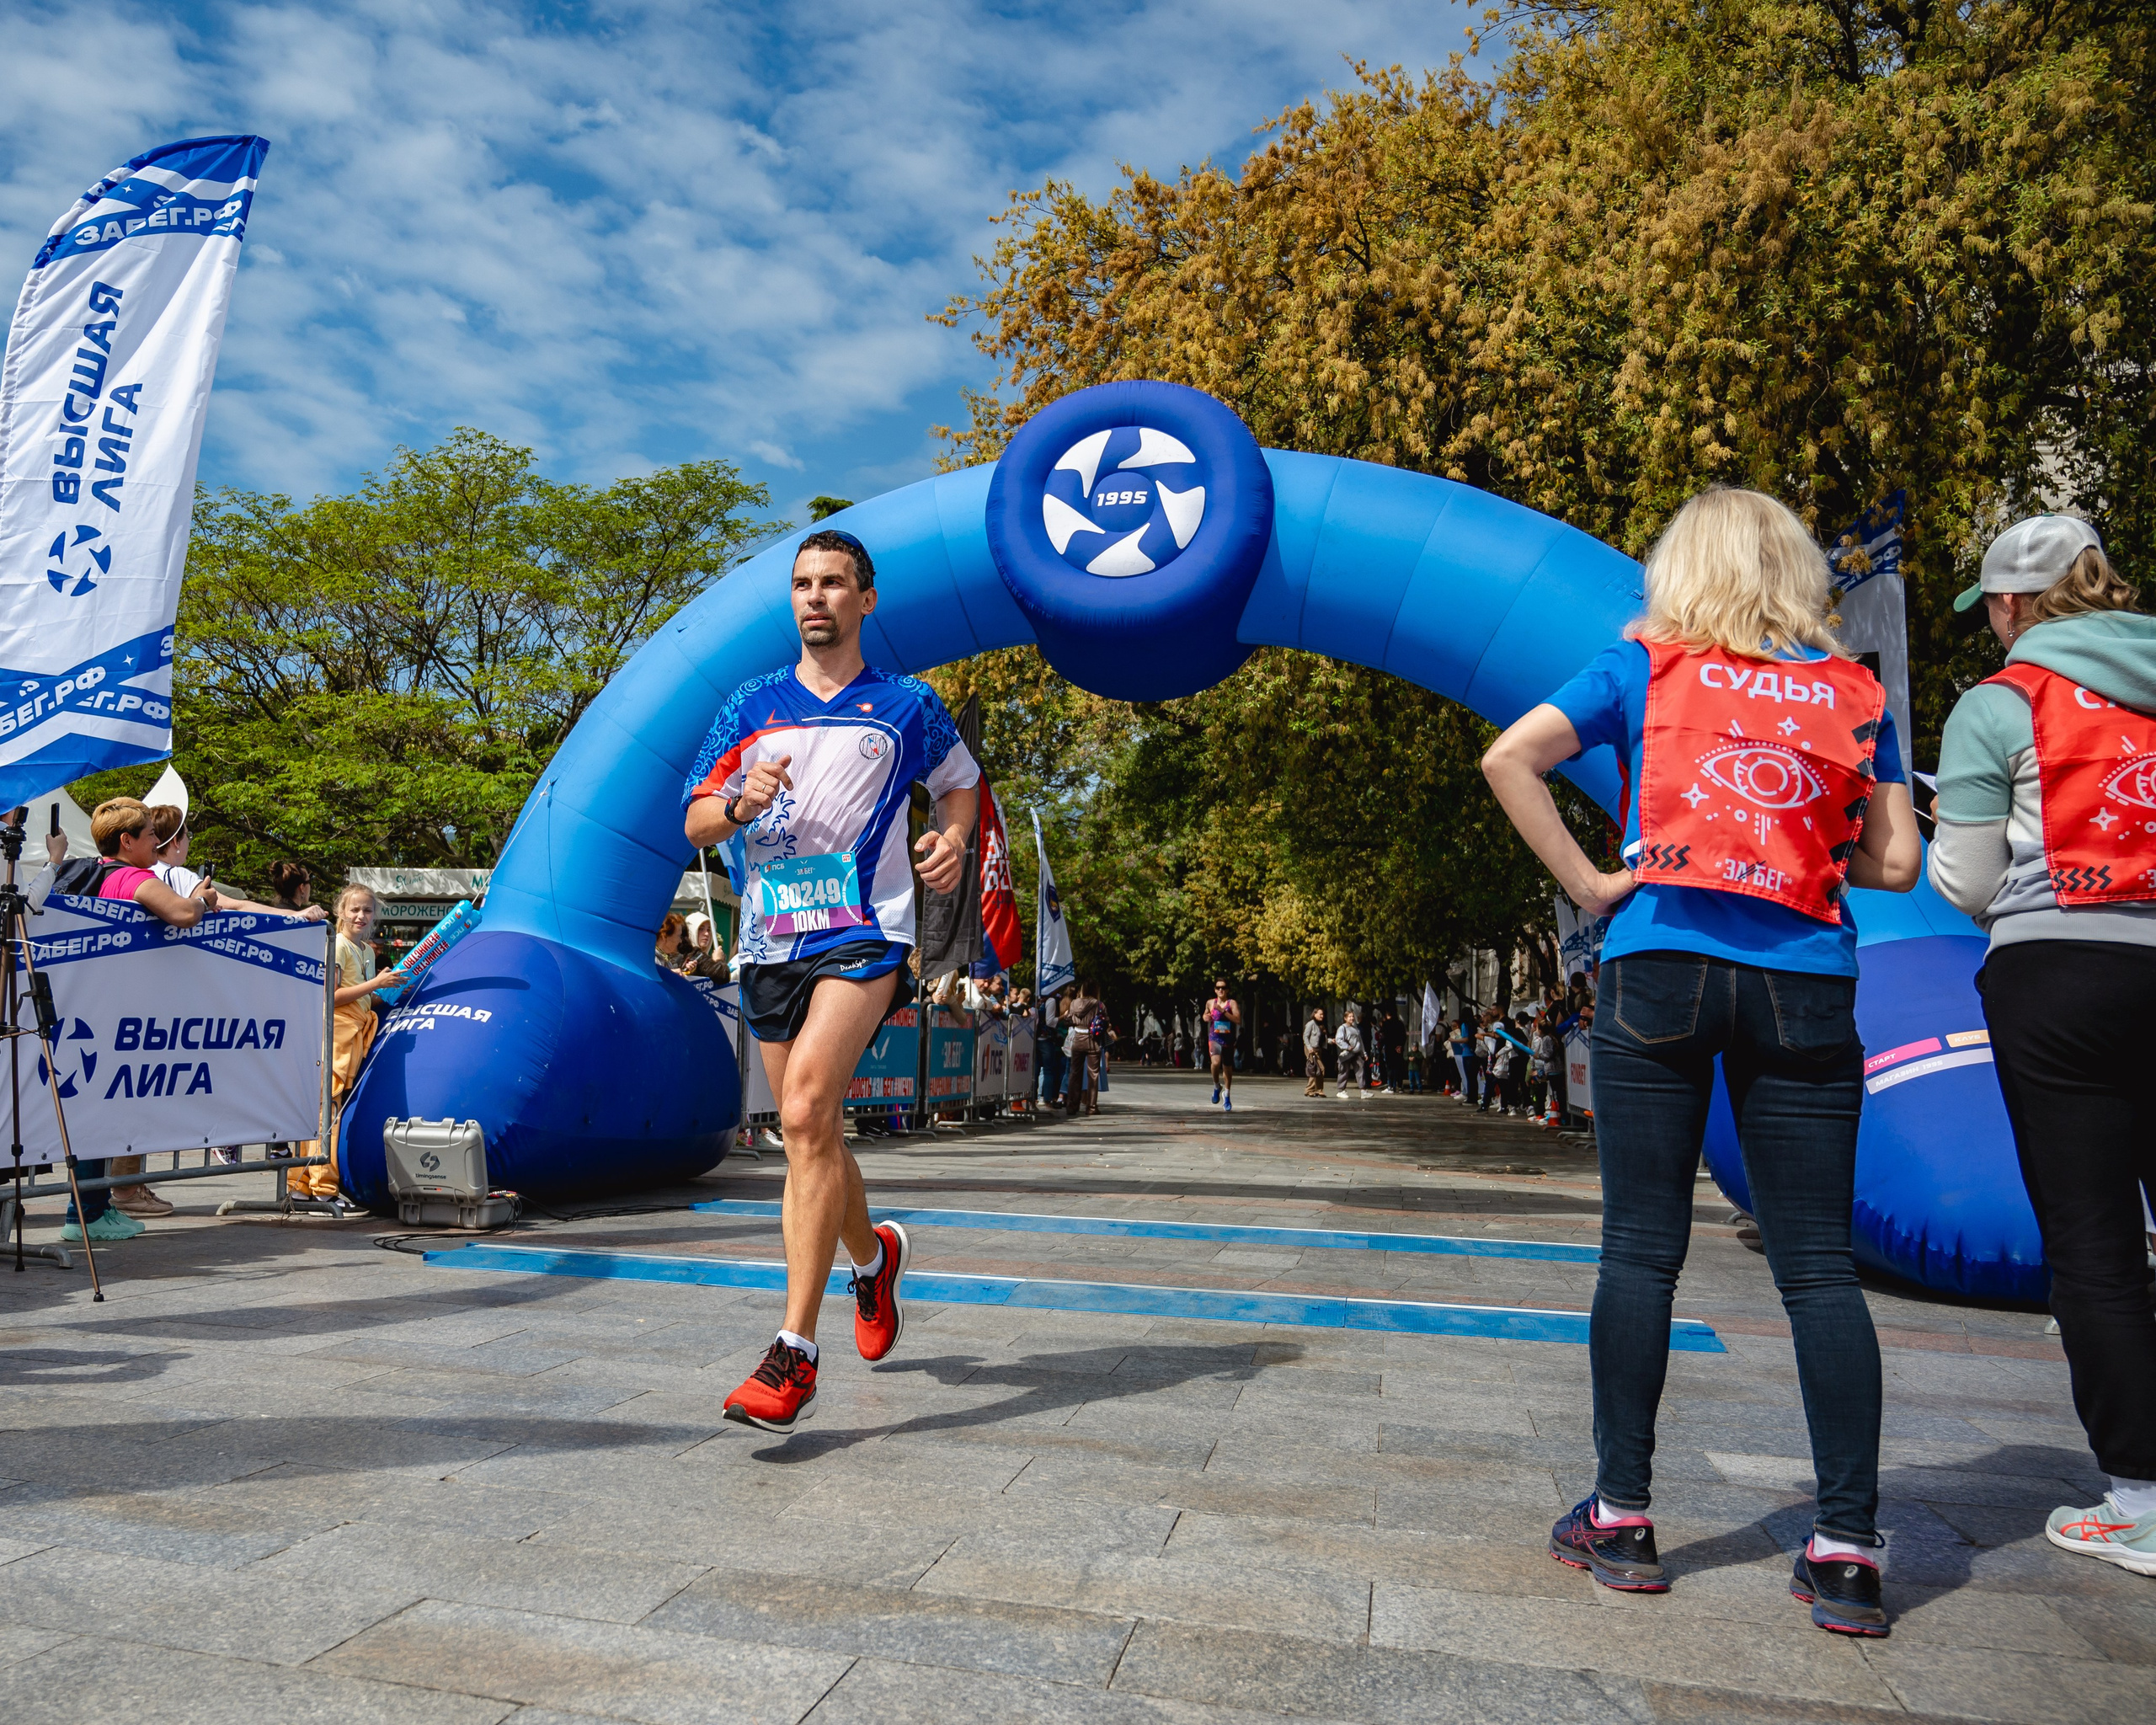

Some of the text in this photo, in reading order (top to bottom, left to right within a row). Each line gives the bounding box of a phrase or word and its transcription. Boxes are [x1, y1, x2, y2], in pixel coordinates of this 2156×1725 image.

[53, 280, 124, 505] ВЫСШАЯ
[92, 382, 143, 513] ЛИГА
[1097, 490, 1148, 507] 1995
[1700, 663, 1836, 710] СУДЬЯ
[771, 862, 785, 871] ПСБ
[777, 878, 841, 911] 30249
[163, 915, 257, 941] ЗАБЕГ.РФ
[402, 930, 442, 969] #ЕДИНСТВО
[386, 1003, 493, 1023] ВЫСШАЯ
[114, 1017, 286, 1052] ВЫСШАЯ
[376, 1017, 435, 1036] ЛИГА
[1954, 1034, 1982, 1043] КЛУБ
[1868, 1053, 1896, 1068] СТАРТ
[104, 1061, 213, 1100] ЛИГА
[1571, 1063, 1586, 1086] FONBET
[1876, 1065, 1919, 1087] МАГАЗИН
